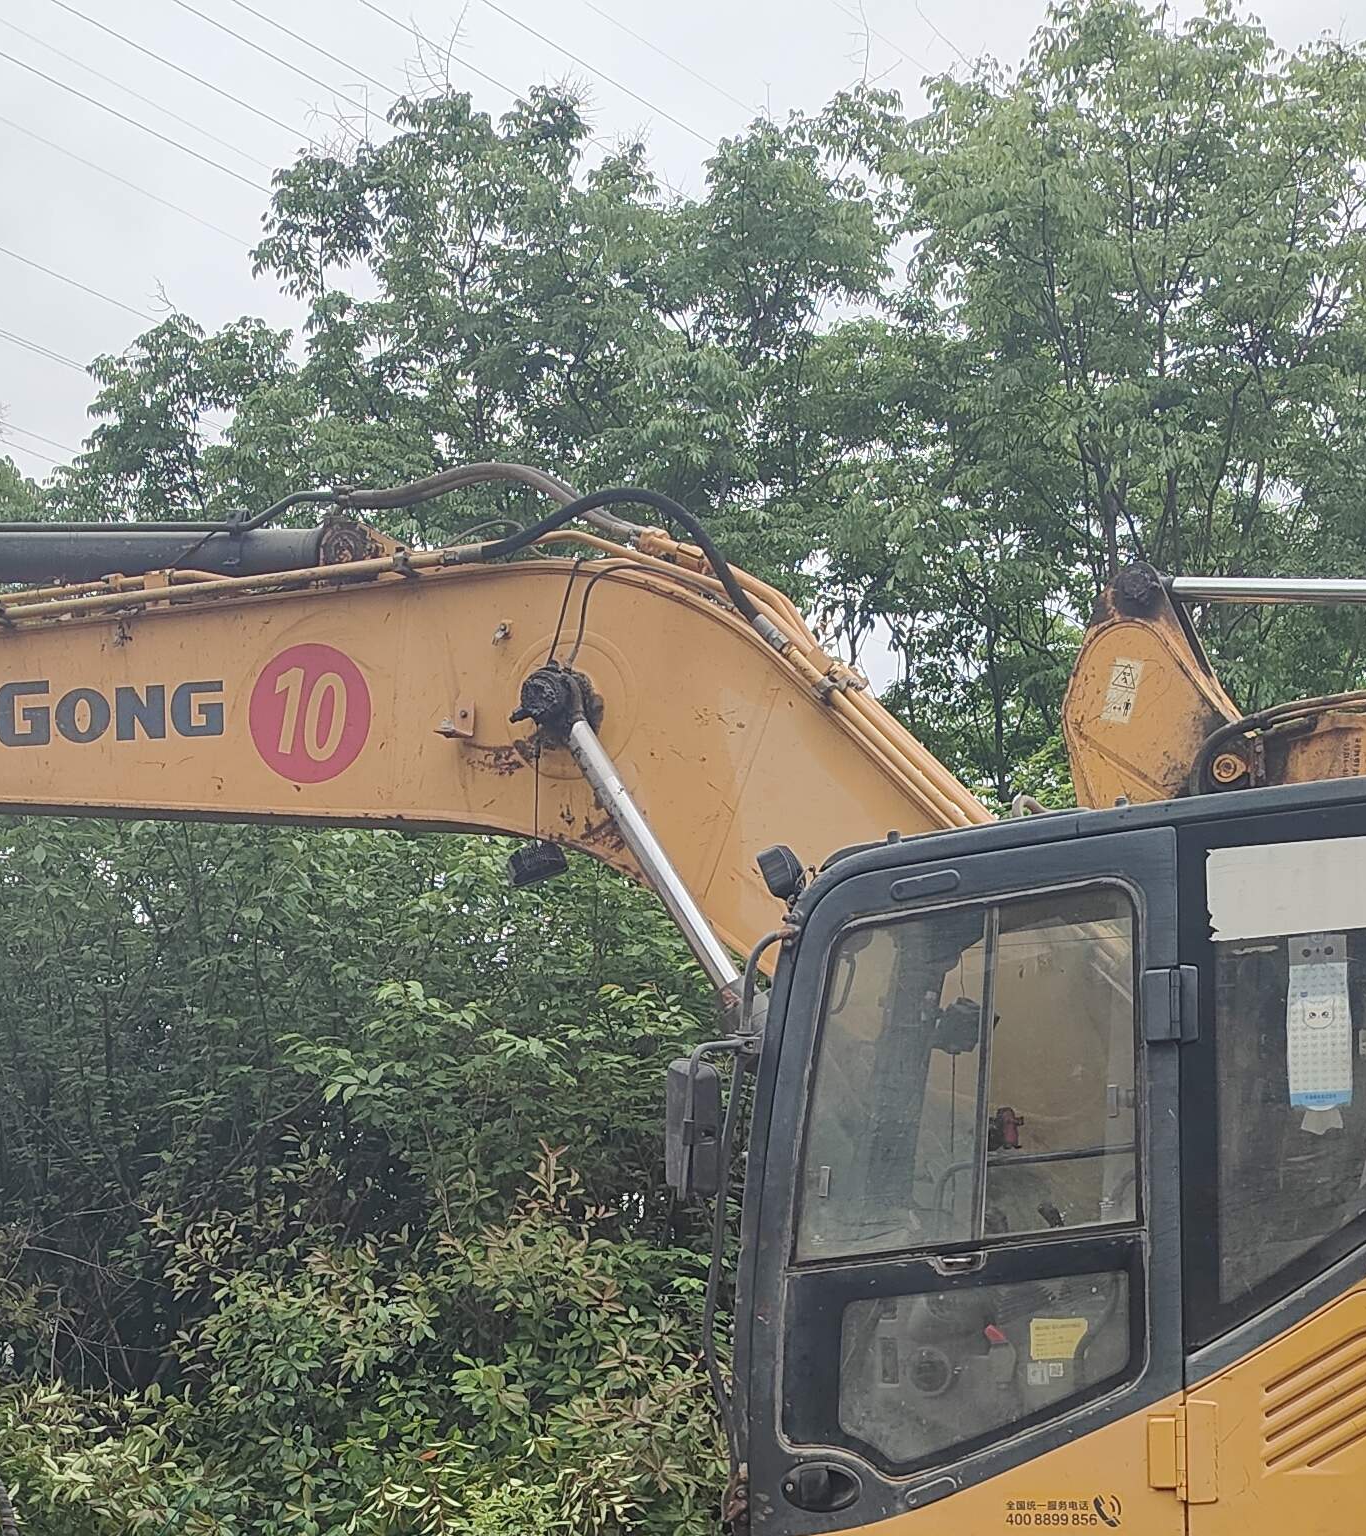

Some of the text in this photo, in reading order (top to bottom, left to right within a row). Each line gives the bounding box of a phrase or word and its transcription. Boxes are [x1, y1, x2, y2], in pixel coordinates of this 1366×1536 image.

[274, 666, 347, 763] 10
[1005, 1500, 1089, 1511] 全国统一服务电话
[1005, 1513, 1098, 1526] 400 8899 856
